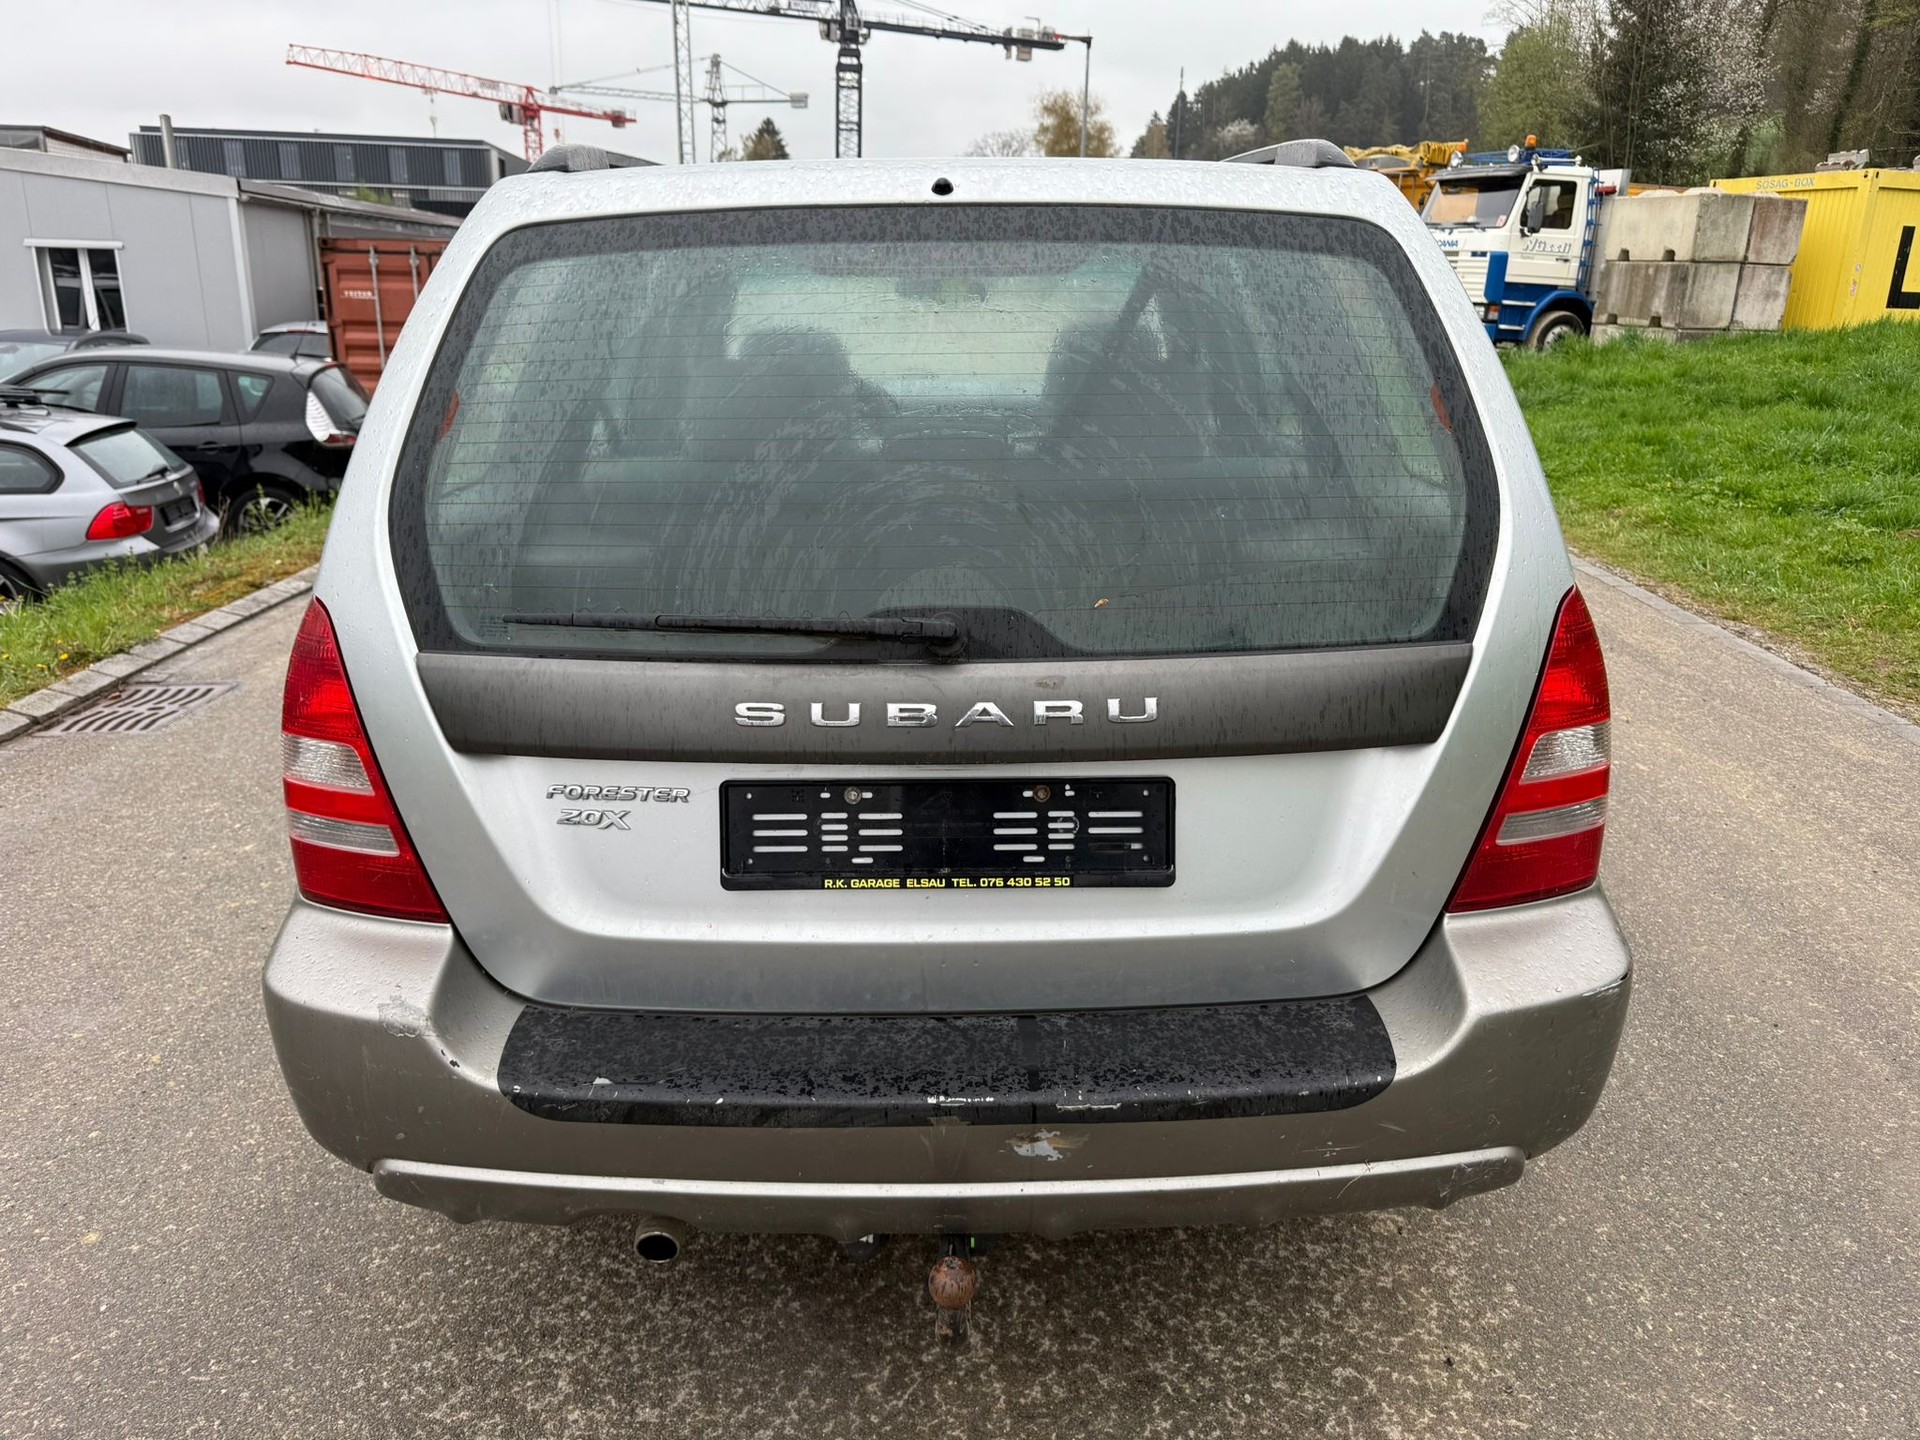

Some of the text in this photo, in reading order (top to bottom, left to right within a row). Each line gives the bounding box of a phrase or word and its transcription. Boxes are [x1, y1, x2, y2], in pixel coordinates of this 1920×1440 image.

[734, 697, 1158, 728] SUBARU
[546, 784, 691, 803] FORESTER
[824, 877, 1070, 888] R.K. GARAGE ELSAU TEL. 076 430 52 50
